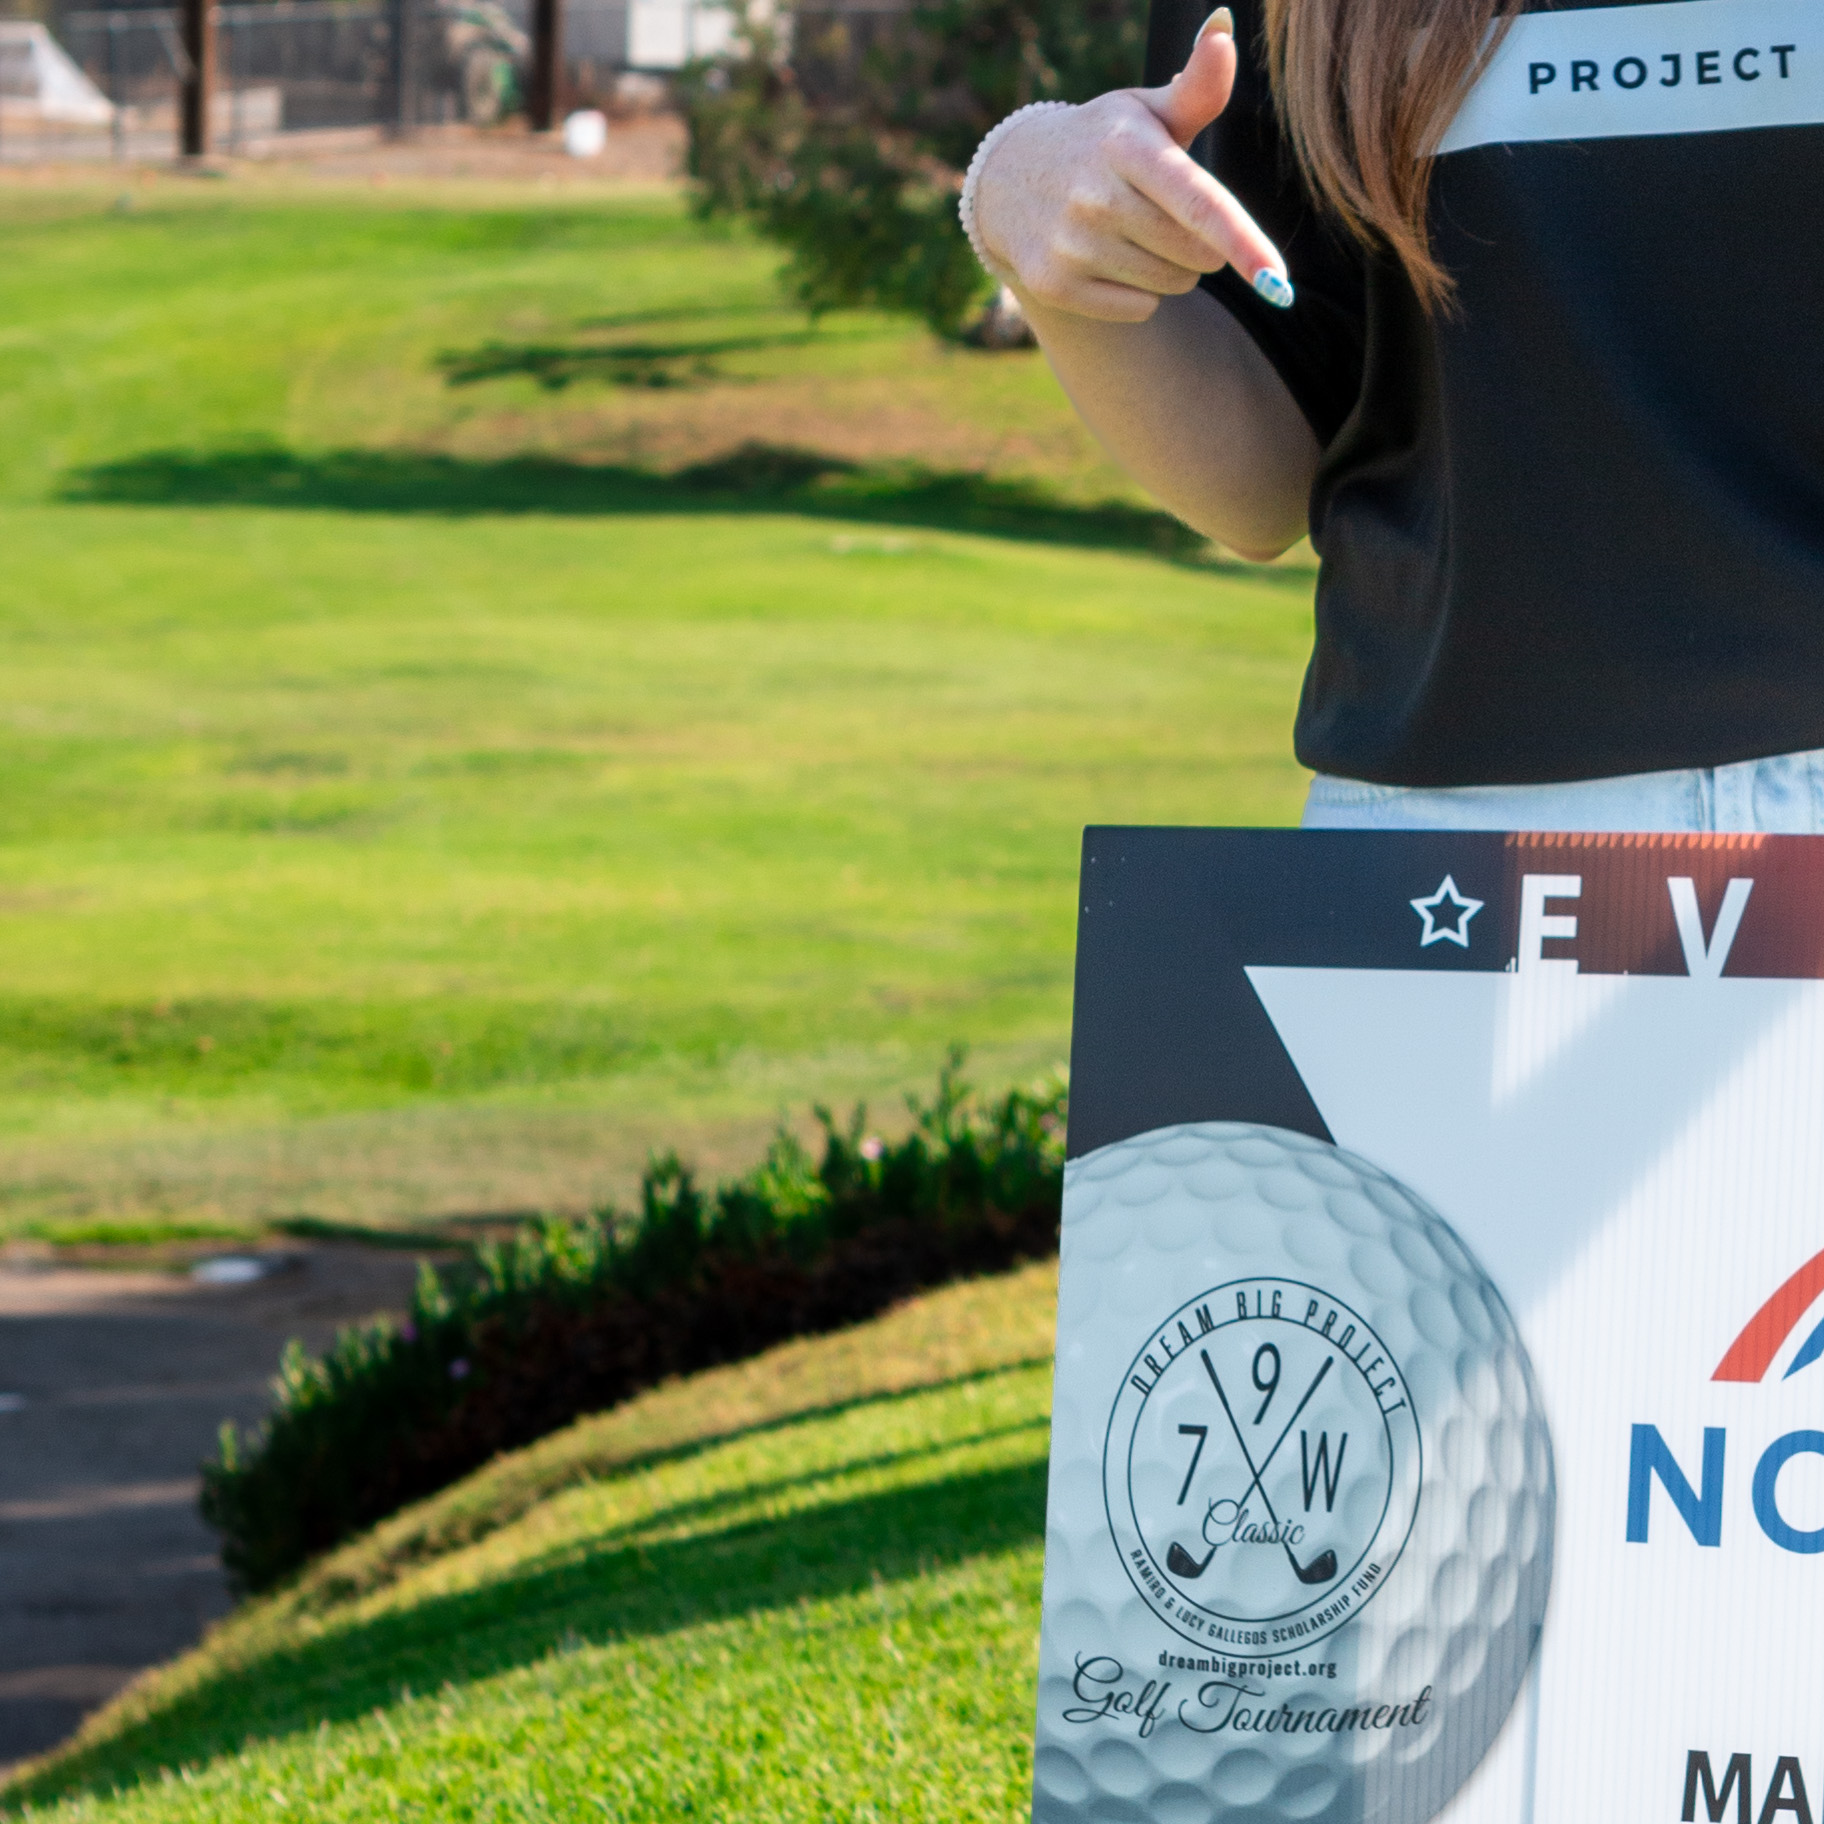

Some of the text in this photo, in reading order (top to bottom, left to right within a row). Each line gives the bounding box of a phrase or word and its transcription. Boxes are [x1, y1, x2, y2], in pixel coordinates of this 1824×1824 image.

[1528, 44, 1798, 95] PROJECT
[1130, 1289, 1406, 1415] DREAM BIG PROJECT
[1252, 1342, 1281, 1425] 9
[1178, 1423, 1348, 1513] 7 W
[1202, 1497, 1307, 1547] Classic
[1130, 1548, 1382, 1645] RAMIRO & LUCY GALLEGOS SCHOLARSHIP FUND
[1061, 1650, 1433, 1739] Golf Tournament
[1158, 1649, 1337, 1678] dreambigproject.org
